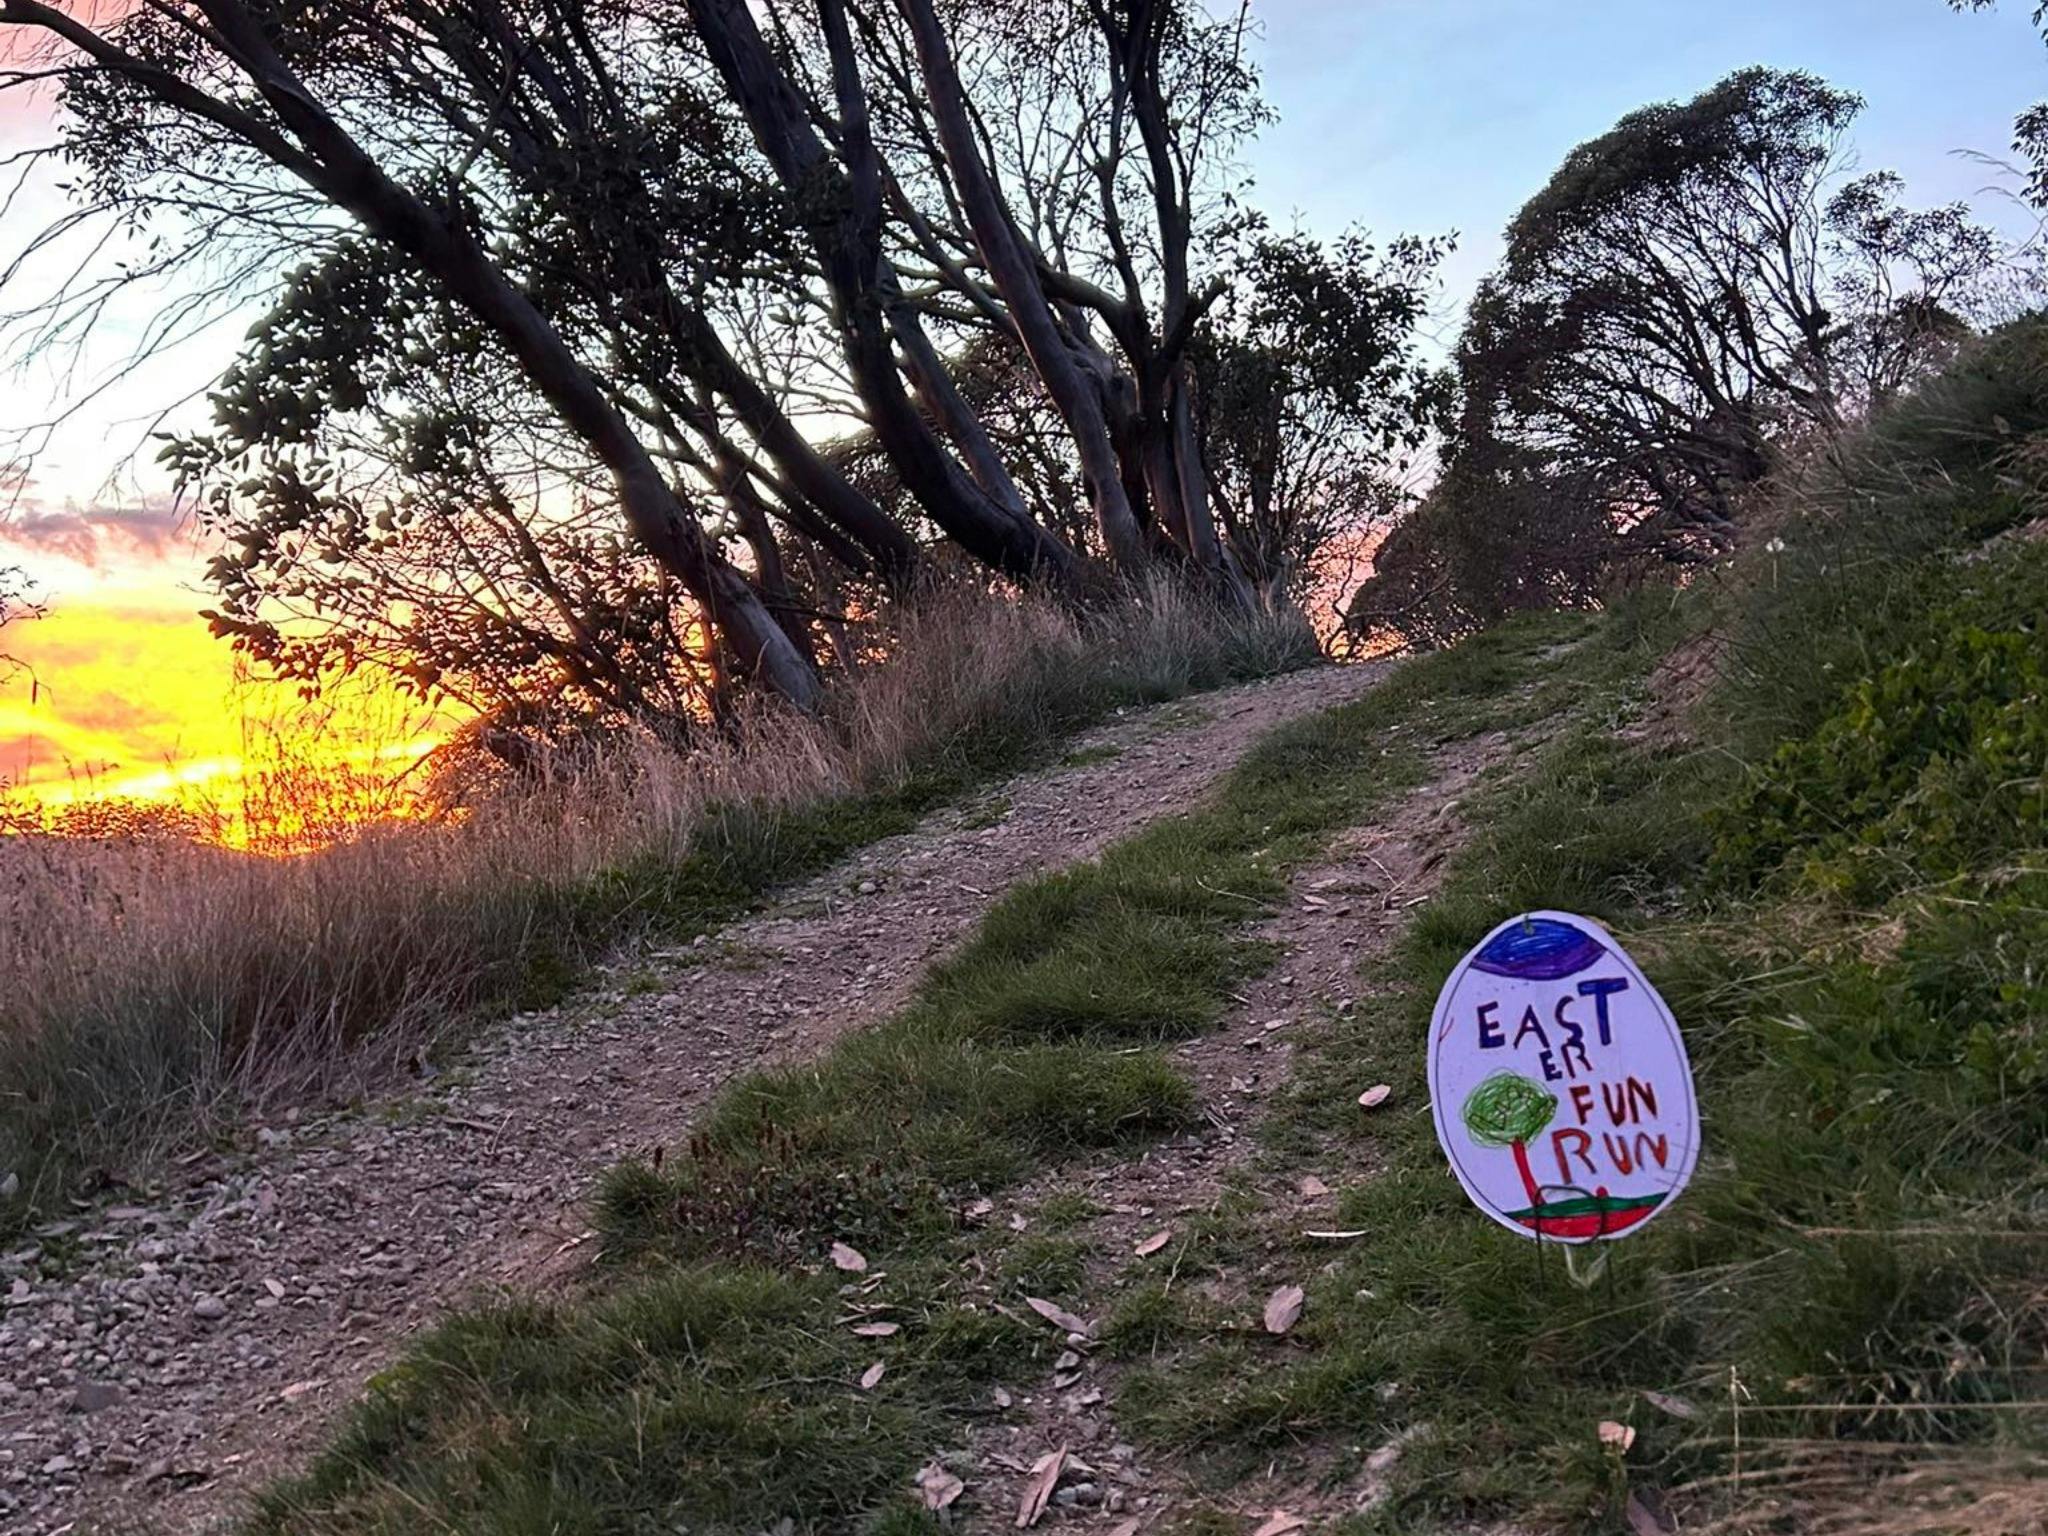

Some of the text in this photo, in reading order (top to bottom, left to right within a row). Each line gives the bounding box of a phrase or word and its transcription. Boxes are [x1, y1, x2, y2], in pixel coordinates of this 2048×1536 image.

[1477, 977, 1629, 1049] EAST
[1539, 1041, 1593, 1081] ER
[1569, 1076, 1658, 1127] FUN
[1552, 1128, 1668, 1185] RUN
